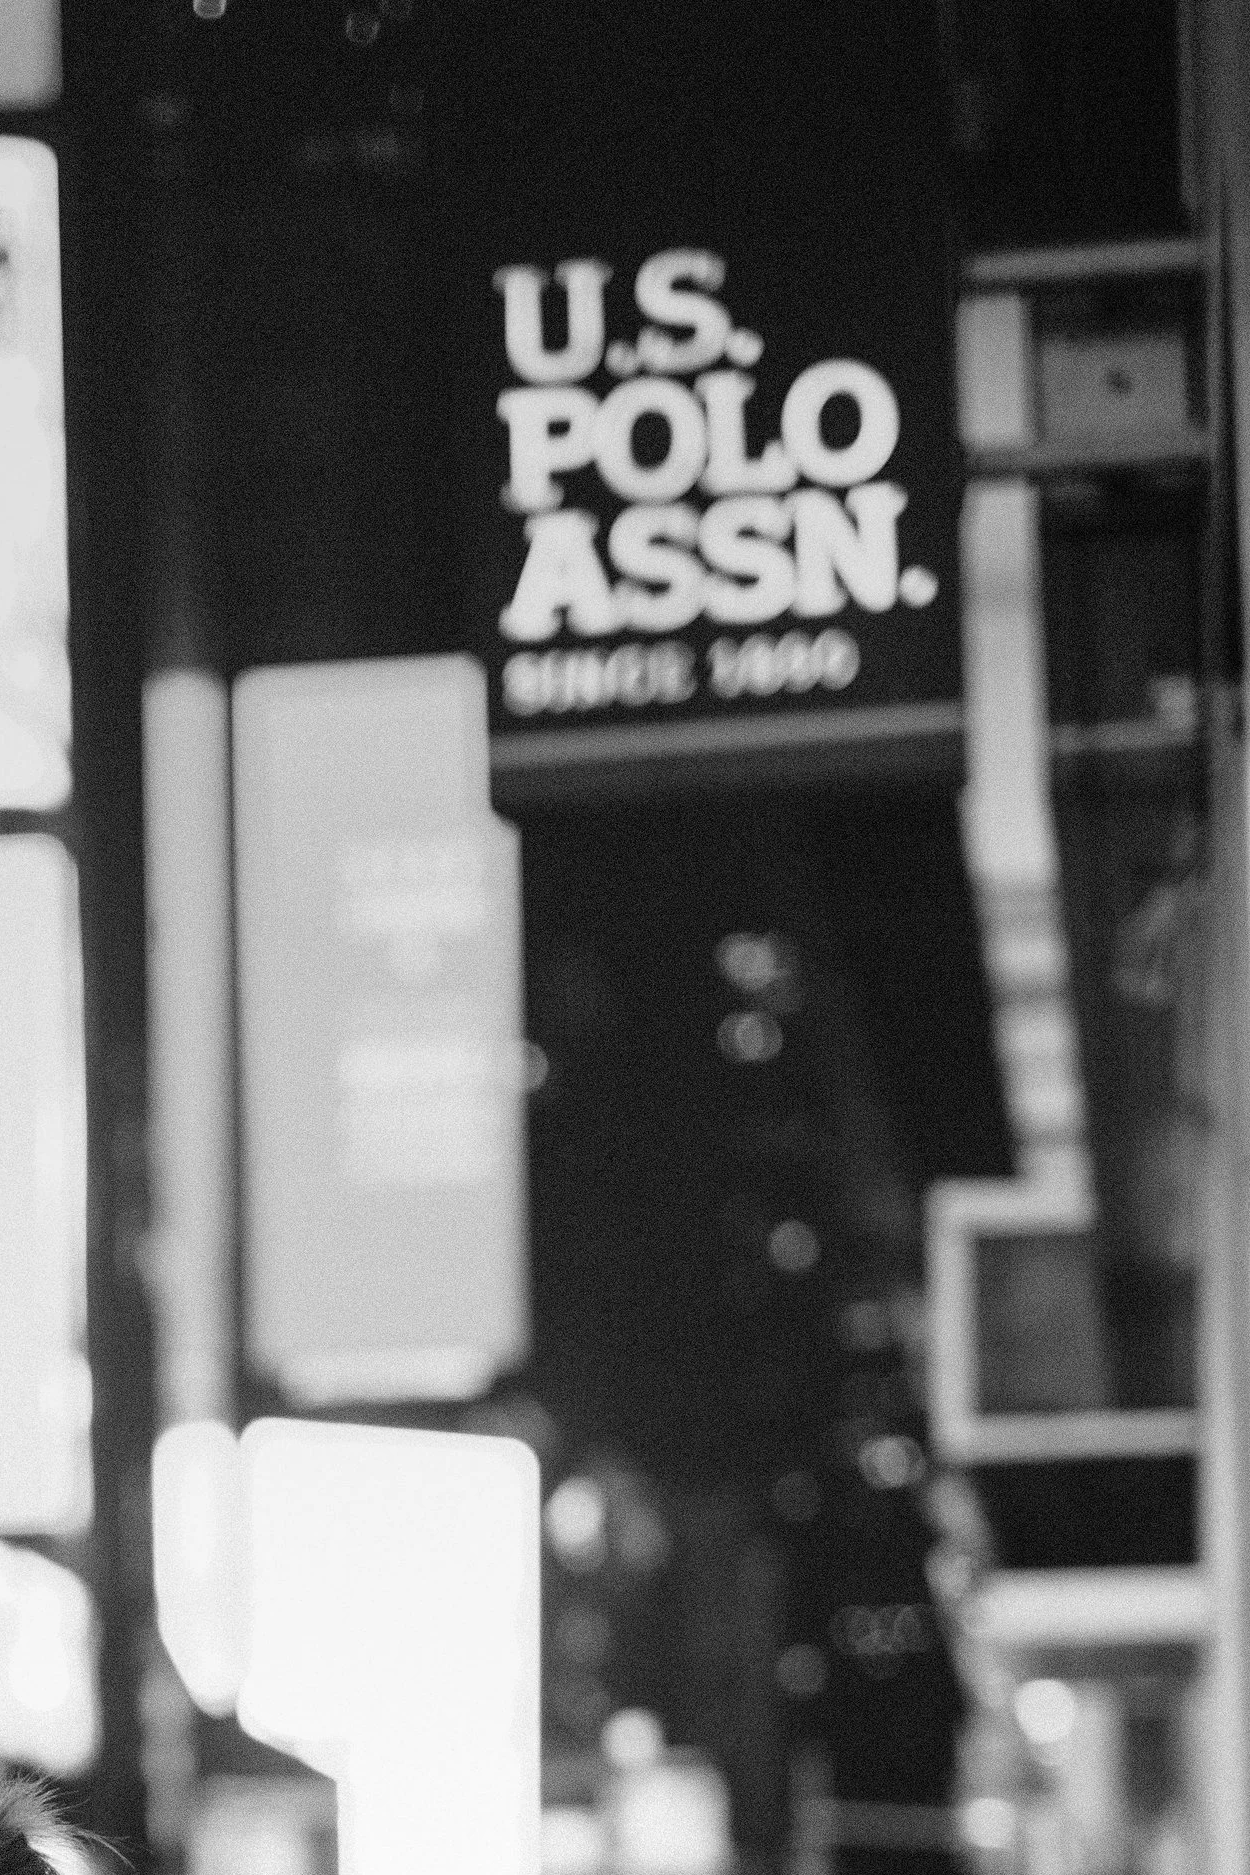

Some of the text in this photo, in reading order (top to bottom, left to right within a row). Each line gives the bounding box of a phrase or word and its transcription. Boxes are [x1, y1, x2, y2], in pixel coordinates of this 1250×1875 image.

[495, 248, 763, 385] U.S.
[497, 358, 900, 513] POLO
[498, 481, 939, 641] ASSN.
[502, 639, 697, 716] SINCE
